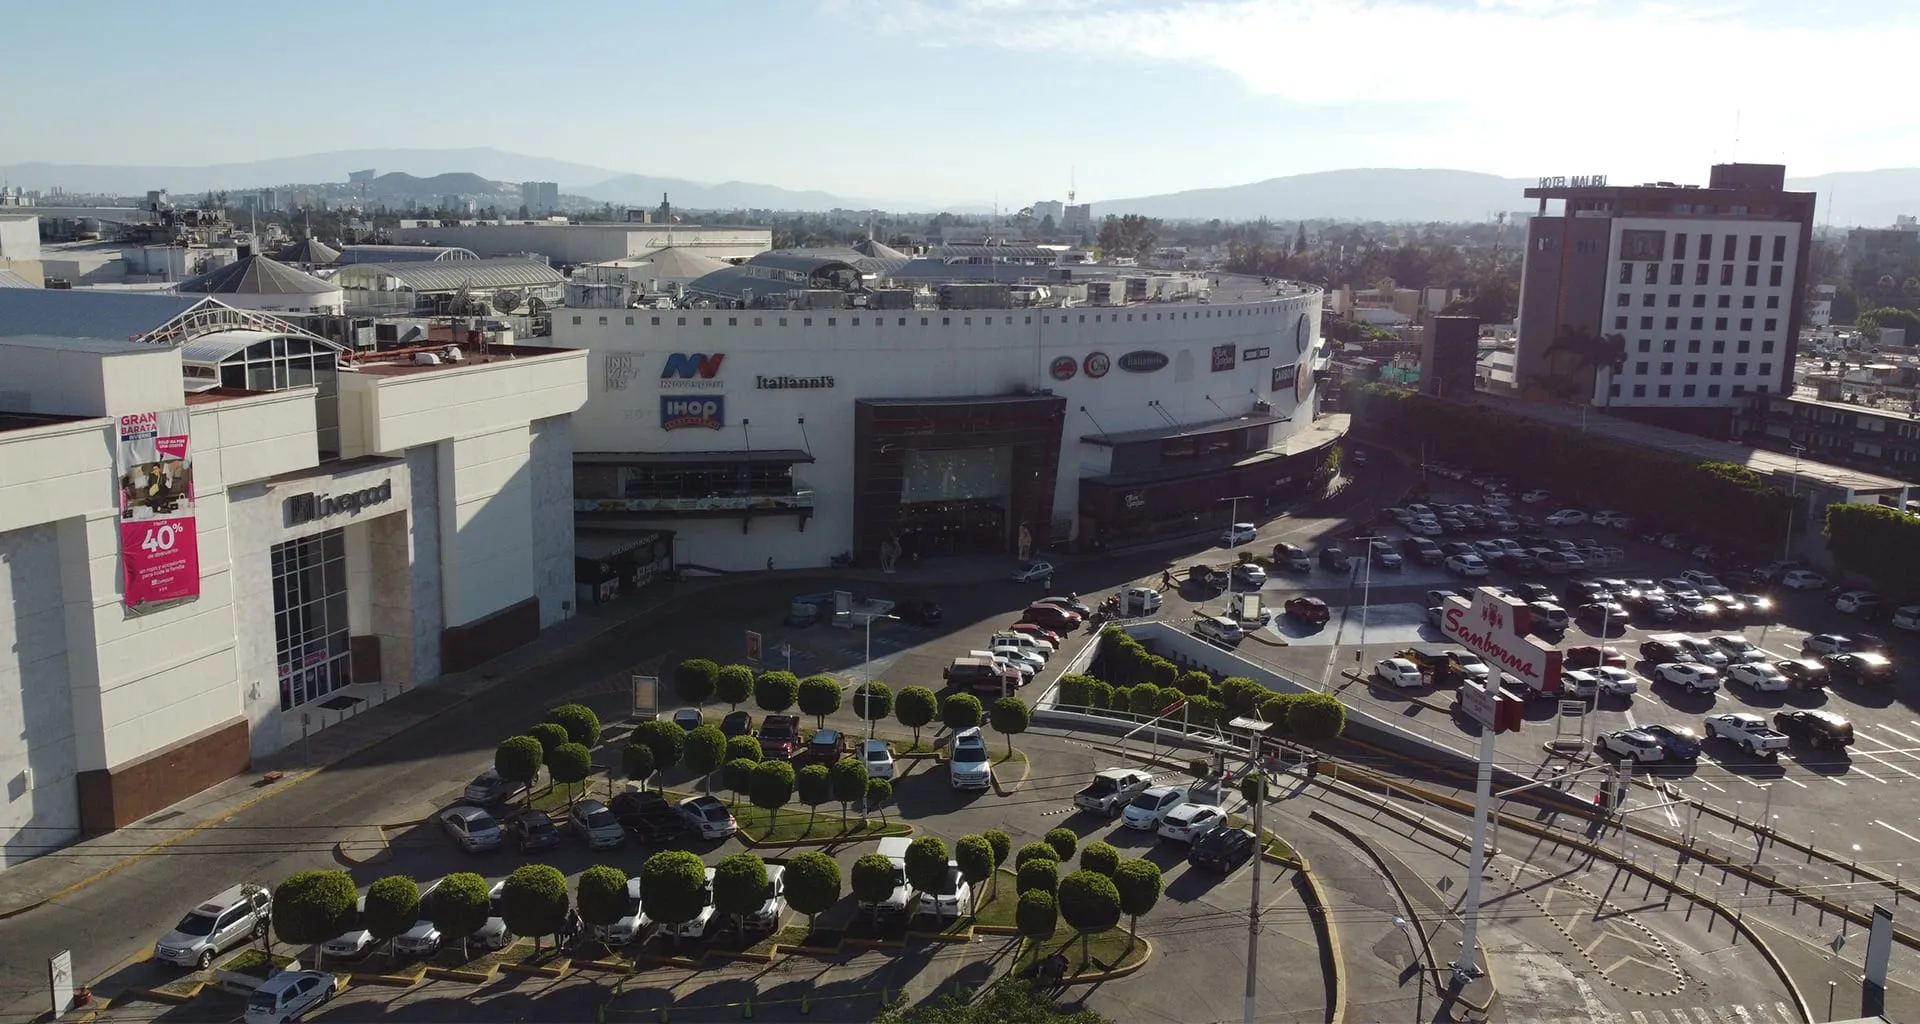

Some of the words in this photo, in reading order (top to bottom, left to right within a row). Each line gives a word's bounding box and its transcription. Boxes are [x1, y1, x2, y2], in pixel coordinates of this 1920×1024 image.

[1538, 176, 1567, 189] HOTEL
[1571, 174, 1607, 188] MALIBU
[756, 375, 835, 390] Italianni's
[121, 411, 157, 426] GRAN
[121, 423, 157, 435] BARATA
[313, 478, 392, 522] Liverpool
[141, 522, 184, 553] 40%
[1444, 608, 1539, 678] Sanborns
